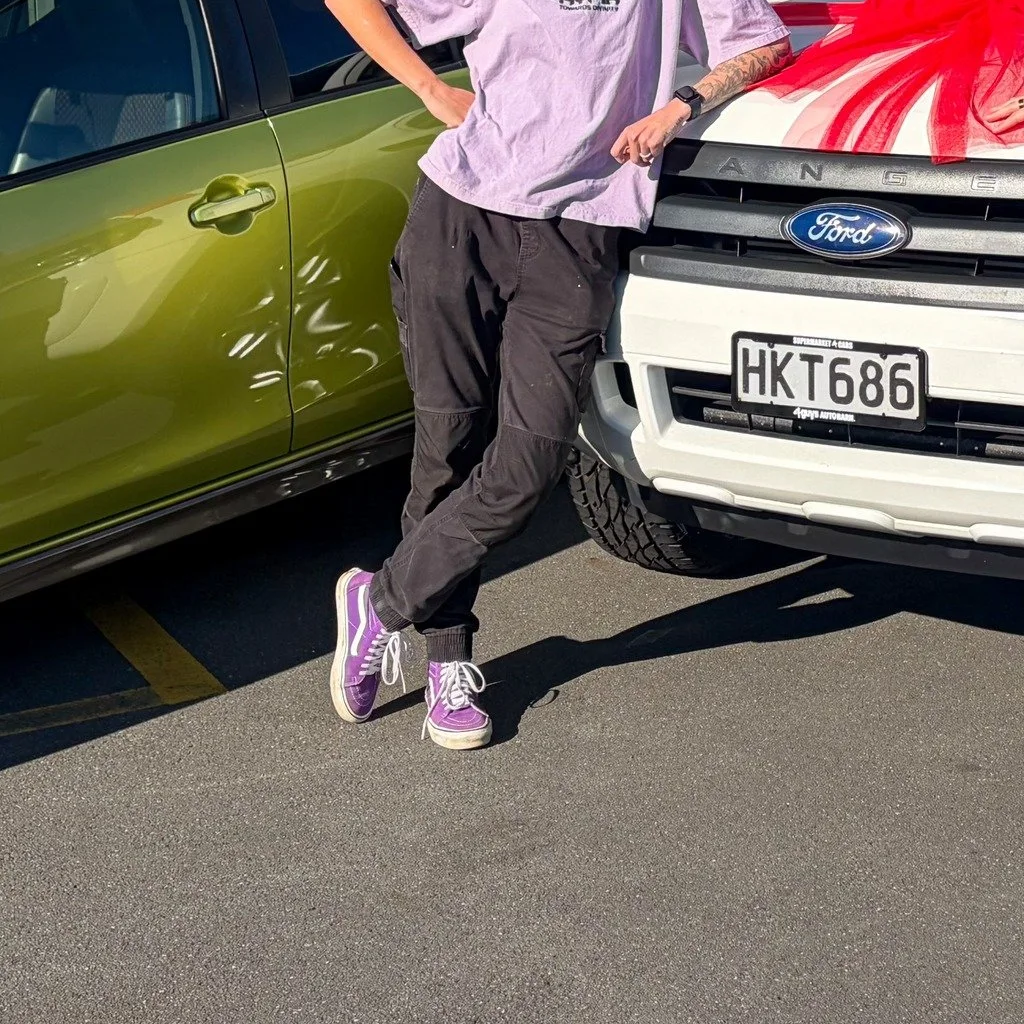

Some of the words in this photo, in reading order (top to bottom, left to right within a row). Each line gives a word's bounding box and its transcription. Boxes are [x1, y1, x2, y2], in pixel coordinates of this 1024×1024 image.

[808, 212, 877, 245] Ford
[793, 336, 832, 347] SUPERMARKET
[742, 347, 915, 411] HKT686
